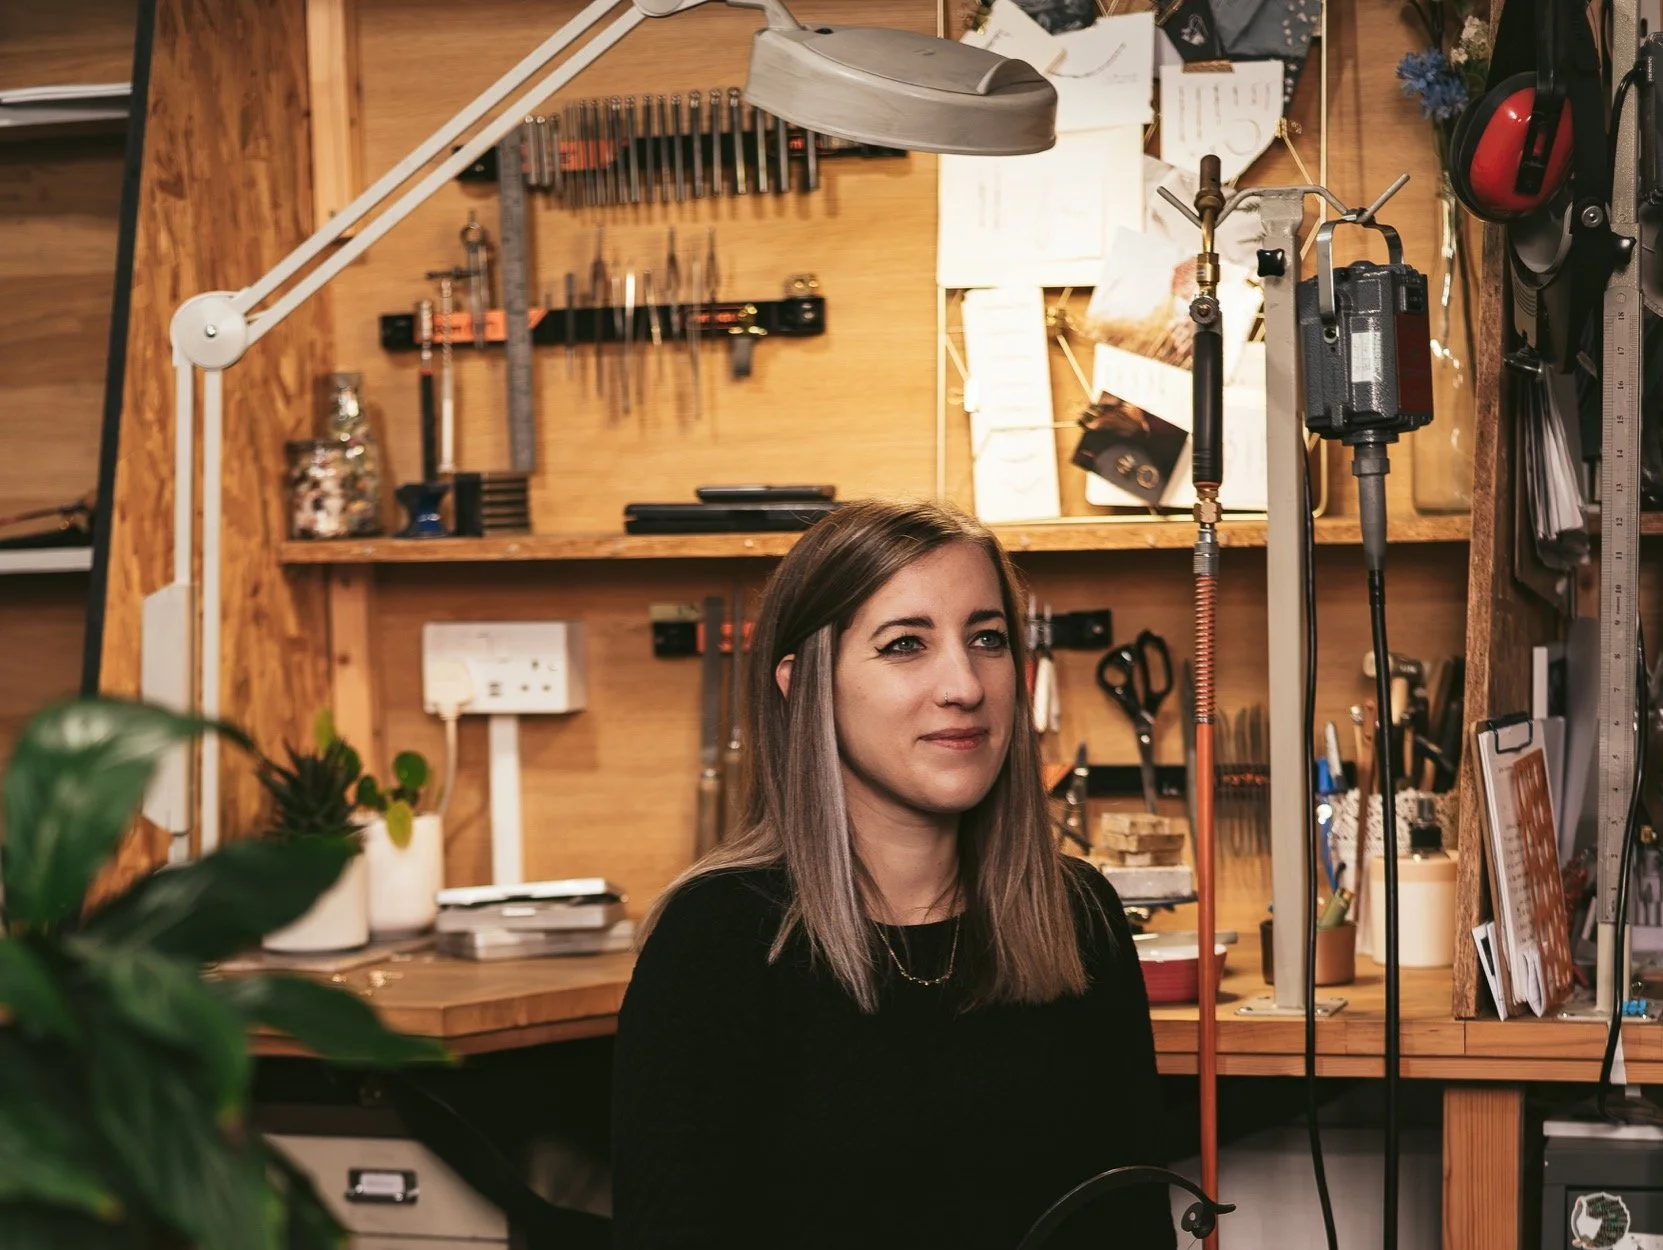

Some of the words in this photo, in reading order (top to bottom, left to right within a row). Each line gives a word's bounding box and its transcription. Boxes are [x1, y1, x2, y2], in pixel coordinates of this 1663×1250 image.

[1618, 311, 1625, 320] 18
[1617, 346, 1625, 355] 17
[1617, 380, 1625, 390] 16
[1616, 415, 1624, 424] 15
[1616, 449, 1624, 458] 14
[1616, 483, 1624, 492] 13
[1615, 517, 1623, 526] 12
[1615, 551, 1622, 560] 11
[1615, 584, 1622, 593] 10
